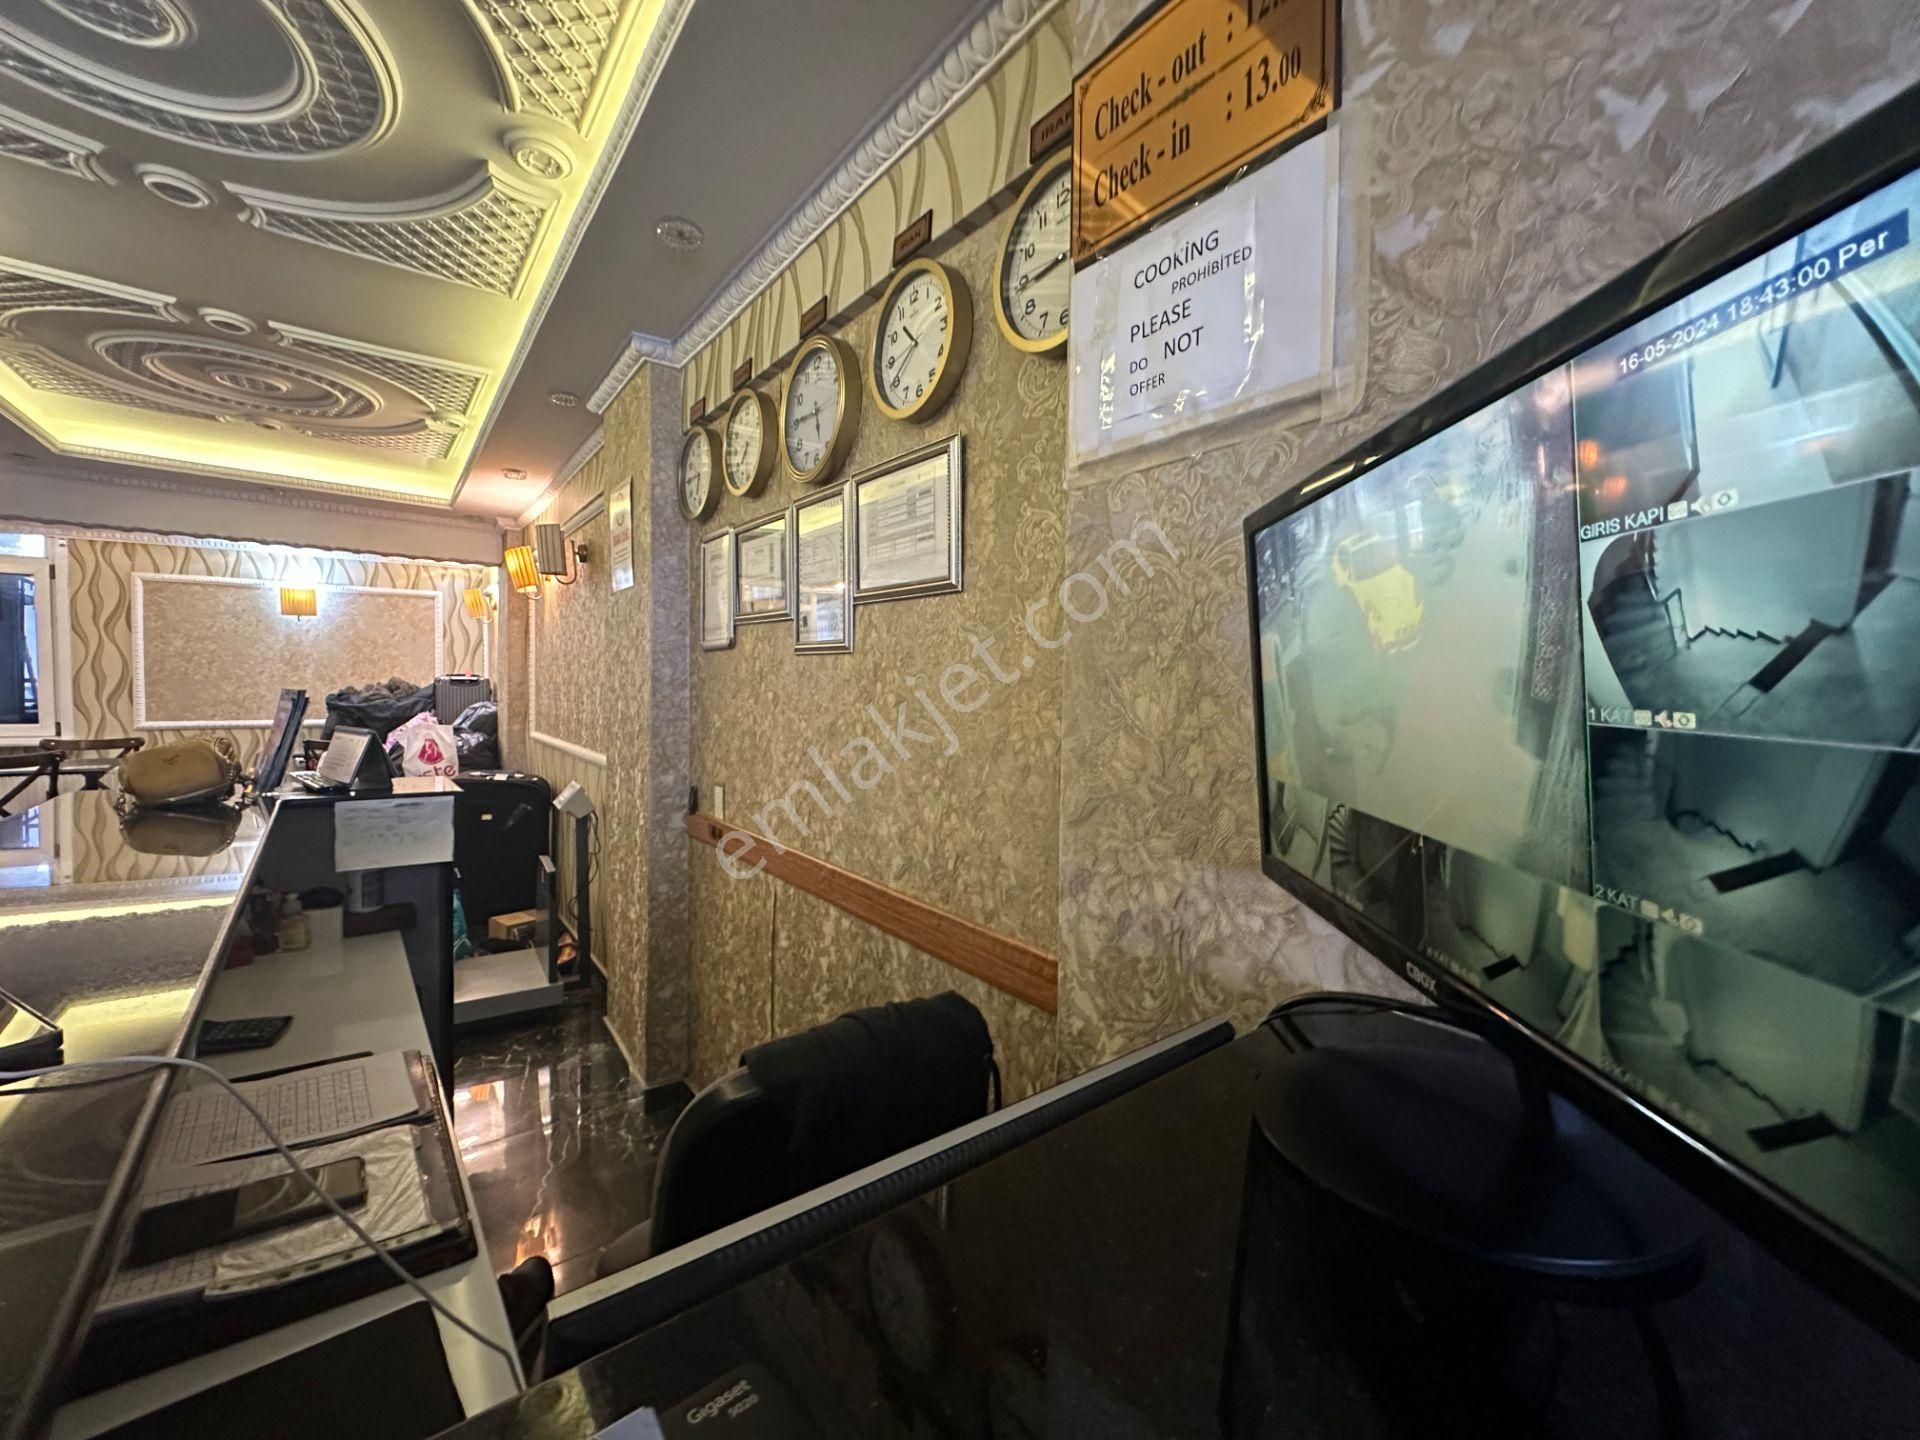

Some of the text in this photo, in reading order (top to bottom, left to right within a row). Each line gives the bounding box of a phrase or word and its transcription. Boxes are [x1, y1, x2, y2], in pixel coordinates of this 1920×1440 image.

[1094, 72, 1153, 141] Check
[1171, 28, 1207, 84] out
[1093, 143, 1152, 208] Check
[1170, 119, 1191, 161] in
[1244, 46, 1301, 112] 13.00
[1130, 298, 1192, 343] PLEASE
[1619, 229, 1889, 375] 16-05-2024 18:43:00 Per
[1129, 326, 1204, 375] DO NOT
[1129, 372, 1166, 397] OFFER
[1580, 506, 1664, 540] GIRIS KAPI
[686, 1379, 752, 1424] Gigaset
